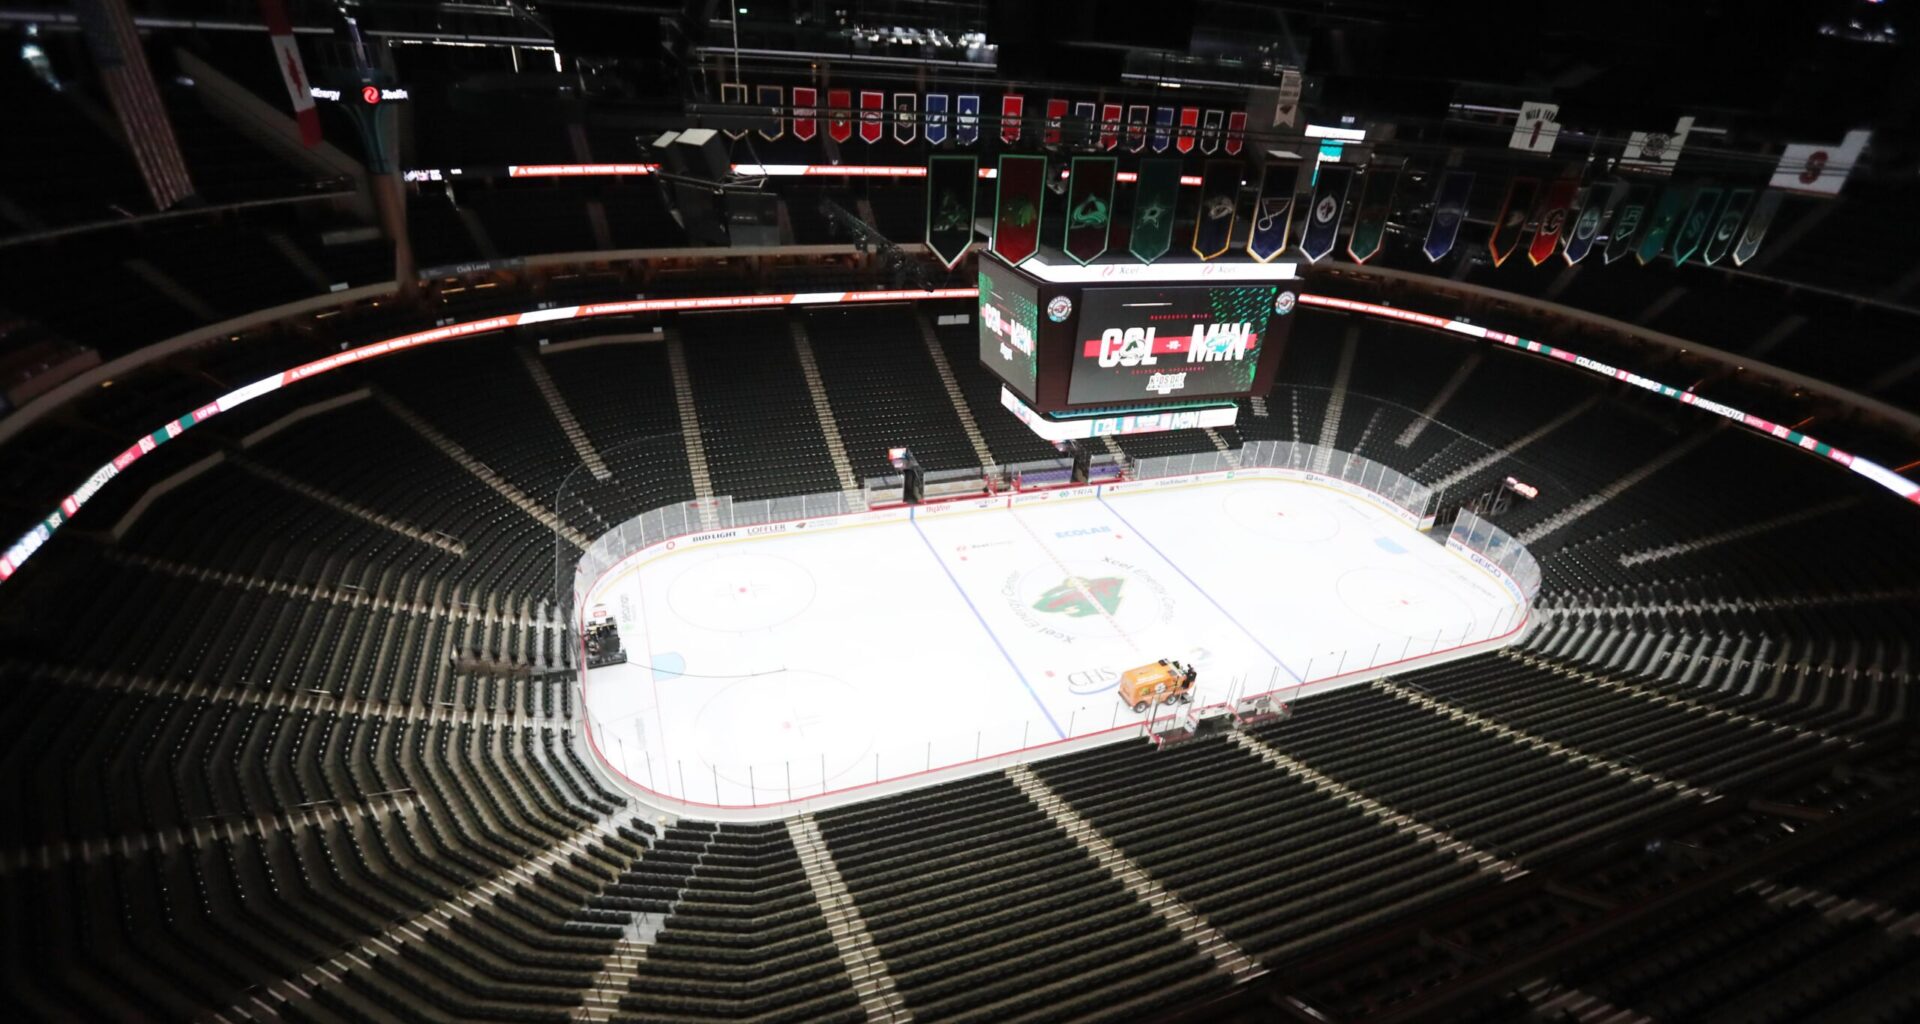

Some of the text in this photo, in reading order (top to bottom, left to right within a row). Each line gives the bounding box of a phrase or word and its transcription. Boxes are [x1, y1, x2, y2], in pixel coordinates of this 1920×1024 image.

[1528, 120, 1543, 149] 1
[357, 344, 388, 357] FUTURE
[388, 339, 411, 349] ONLY
[1098, 327, 1158, 368] COL
[1187, 322, 1251, 363] MIN
[1576, 356, 1617, 377] COLORADO
[1693, 396, 1745, 422] MINNESOTA
[692, 531, 736, 543] BUD LIGHT
[747, 524, 786, 535] LOFFLER
[1055, 525, 1112, 539] ECOLAB
[1102, 556, 1133, 570] Xcel
[1470, 553, 1501, 578] GEICO
[1040, 626, 1075, 644] Xcel
[1068, 667, 1118, 688] CHS
